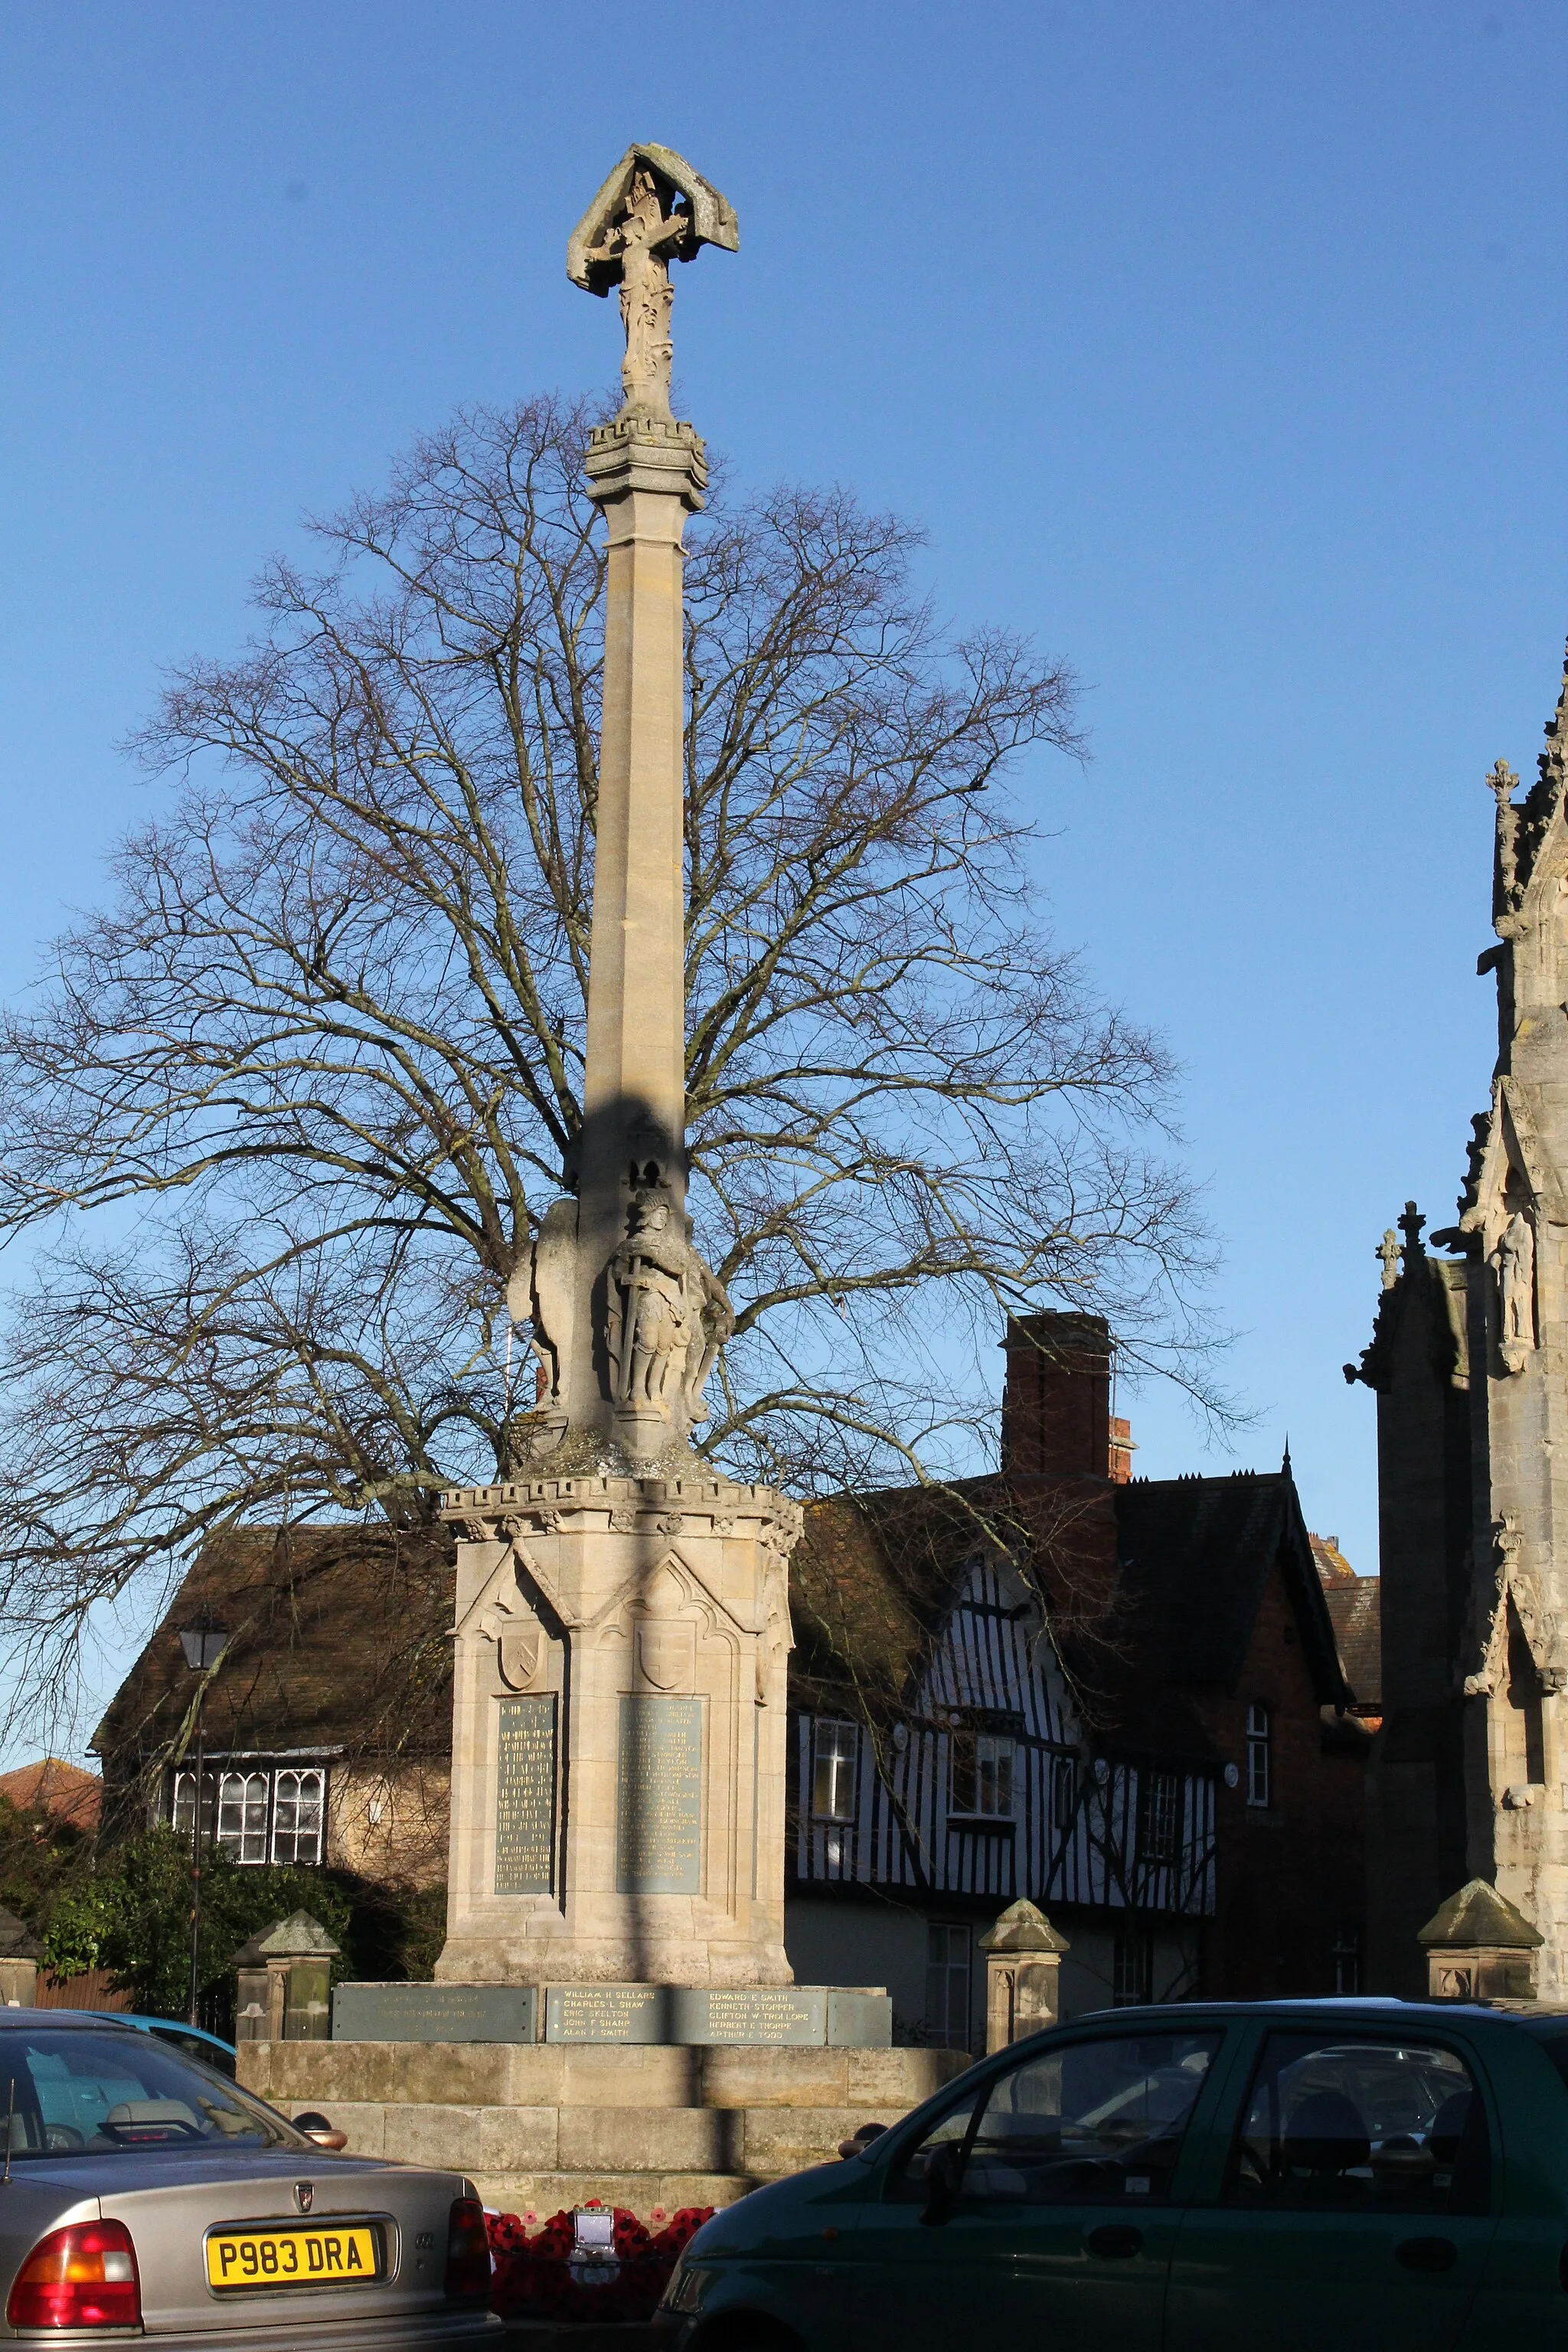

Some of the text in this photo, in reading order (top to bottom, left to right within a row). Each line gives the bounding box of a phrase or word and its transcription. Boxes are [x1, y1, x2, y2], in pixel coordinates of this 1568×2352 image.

[709, 1993, 747, 2001] EDWARD
[709, 2002, 795, 2011] KENNETH STOPPER
[588, 2010, 629, 2018] SKELTON
[709, 2011, 747, 2020] CLIFTON
[219, 2236, 363, 2277] P983 DRA
